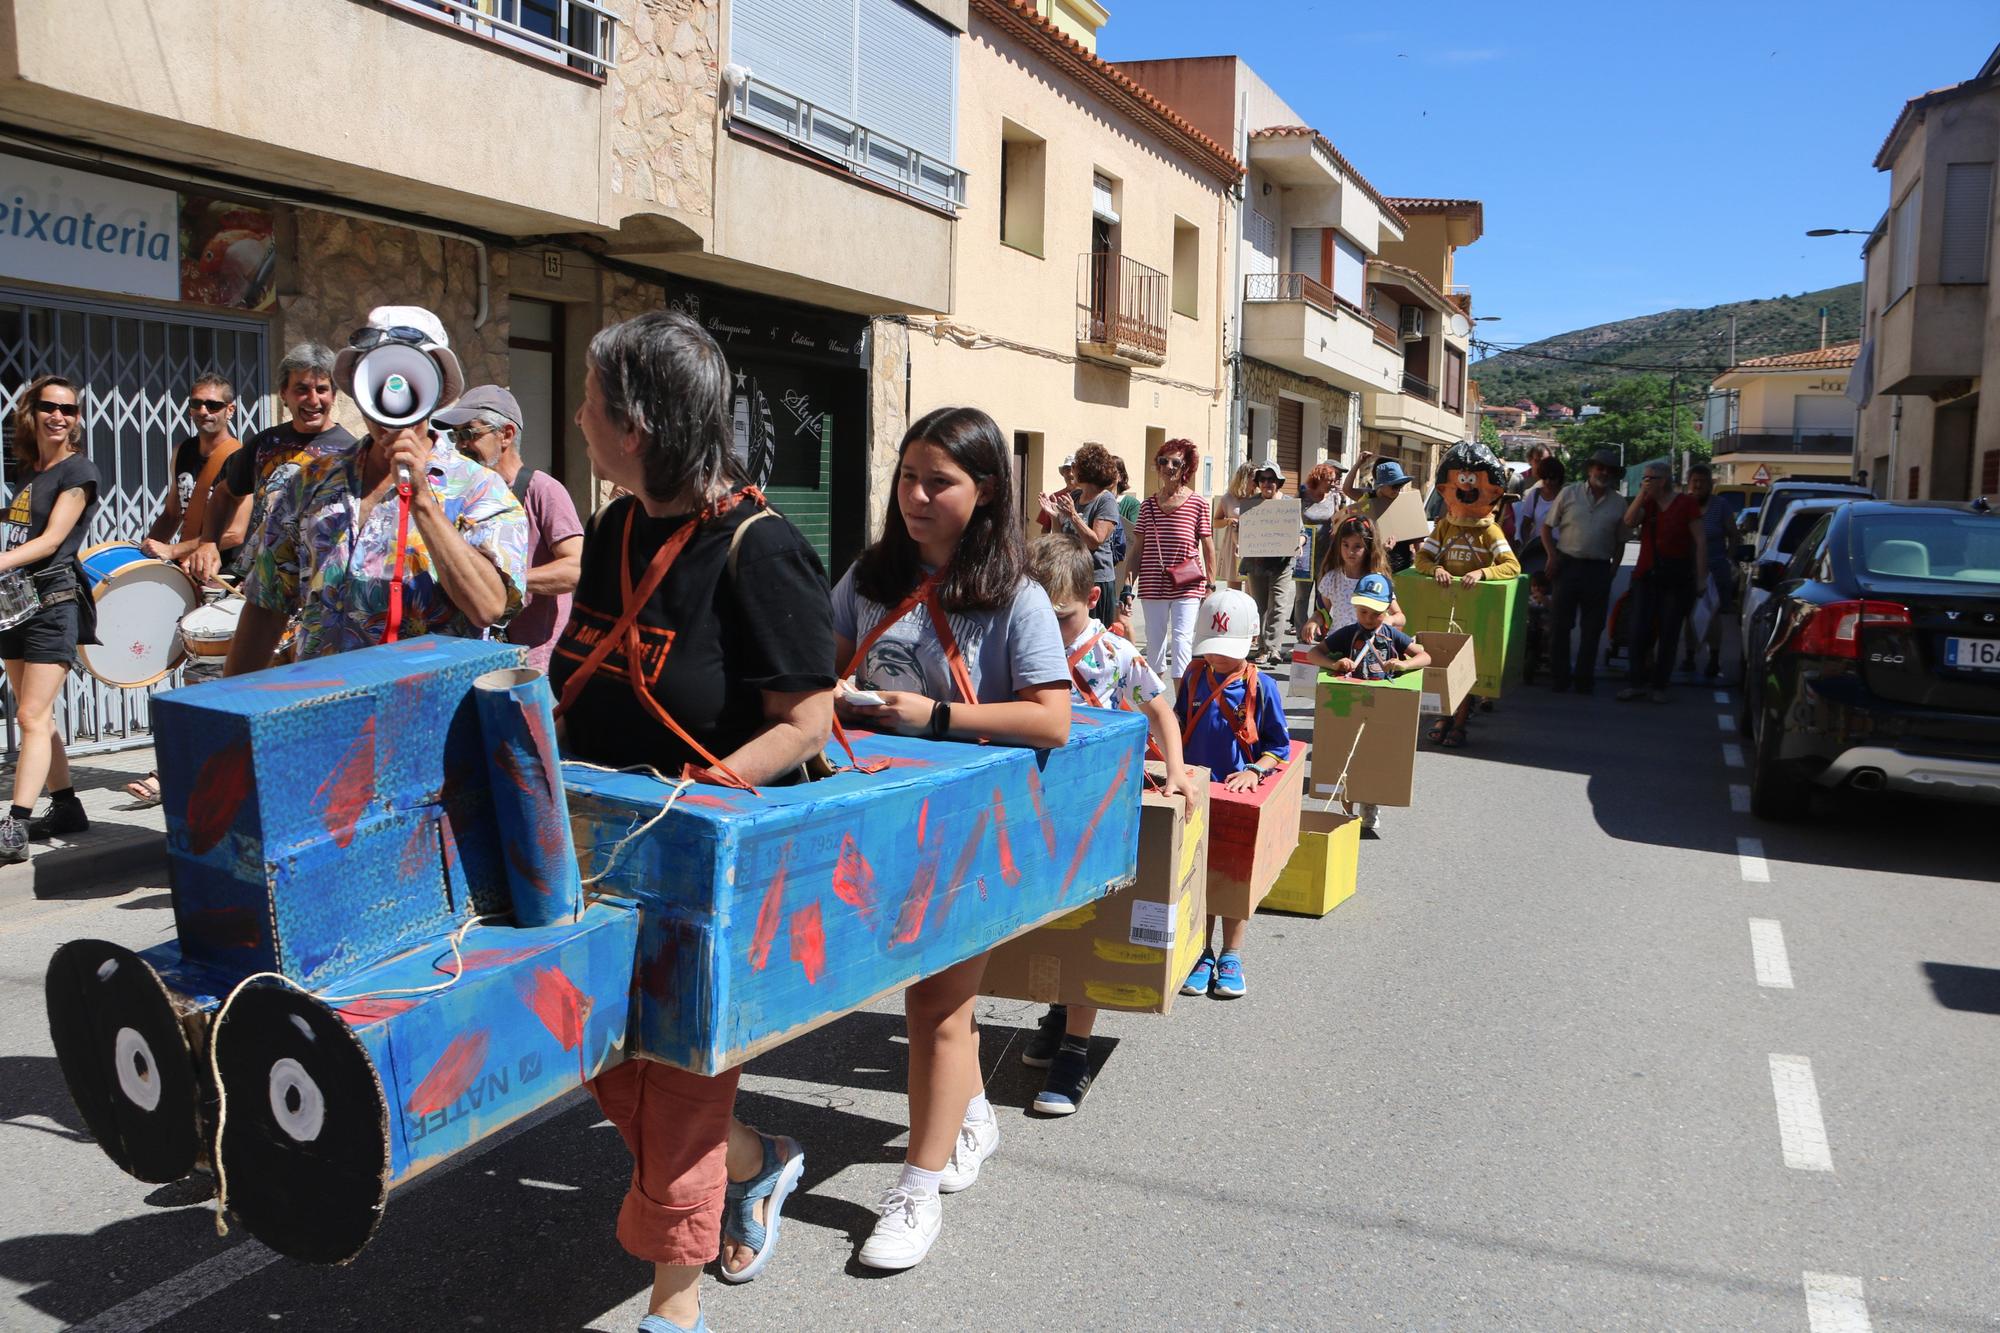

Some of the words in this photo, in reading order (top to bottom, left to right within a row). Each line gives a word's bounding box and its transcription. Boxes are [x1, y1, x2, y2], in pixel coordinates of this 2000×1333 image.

[548, 255, 558, 272] 13
[782, 389, 825, 436] Style
[1211, 611, 1230, 632] NY
[1870, 653, 1905, 664] S60
